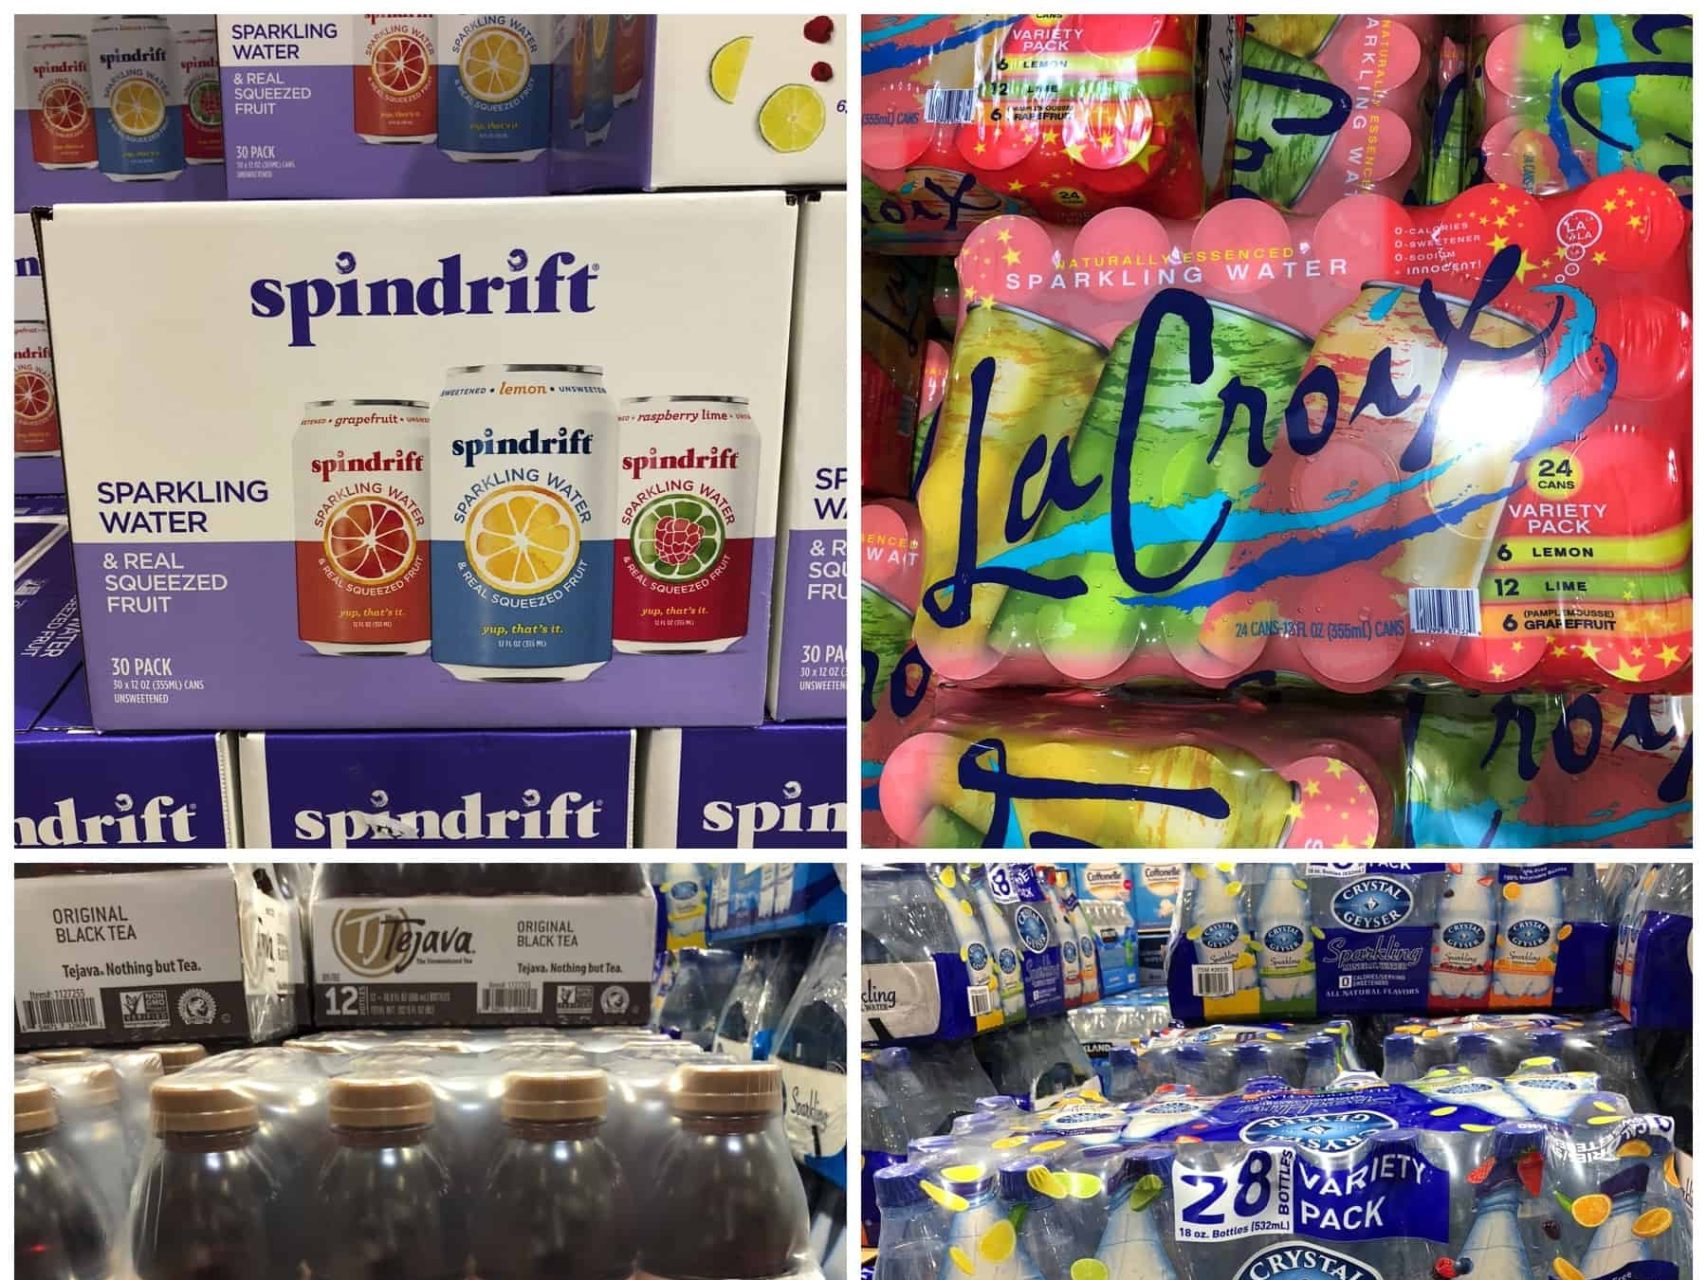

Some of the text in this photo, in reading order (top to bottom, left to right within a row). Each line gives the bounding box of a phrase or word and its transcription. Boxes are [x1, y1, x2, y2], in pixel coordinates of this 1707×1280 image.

[231, 23, 338, 41] SPARKLING
[1013, 29, 1084, 40] VARIETY
[232, 44, 300, 60] WATER
[1023, 41, 1069, 51] PACK
[234, 72, 284, 85] & REAL
[234, 87, 311, 100] SQUEEZED
[235, 103, 276, 115] FRUIT
[236, 145, 275, 159] 30 PACK
[1182, 247, 1294, 263] ESSENCED
[1006, 258, 1349, 289] SPARKLING WATER
[250, 250, 599, 347] spindrift
[499, 381, 547, 397] lemon
[334, 413, 398, 427] grapefruit
[637, 408, 728, 423] raspberry lime
[452, 427, 594, 467] spindrift
[312, 450, 424, 481] spindrift
[622, 448, 738, 479] spindrift
[1538, 459, 1573, 477] 24
[97, 481, 268, 504] SPARKLING
[1538, 481, 1575, 490] CANS
[1509, 503, 1607, 518] VARIETY
[98, 511, 208, 533] WATER
[1528, 519, 1591, 534] PACK
[103, 553, 184, 569] & REAL
[1497, 544, 1594, 562] 6 LEMON
[105, 574, 228, 591] SQUEEZED
[1494, 578, 1587, 597] 12 LIME
[108, 596, 171, 613] FRUIT
[1235, 621, 1405, 637] 24 CANS
[1503, 614, 1518, 632] 6
[1524, 619, 1616, 631] GRAPEFRUIT
[111, 658, 172, 676] 30 PACK
[114, 694, 169, 704] UNSWEETENED
[1342, 879, 1403, 900] CRYSTAL
[52, 905, 128, 924] ORIGINAL
[1342, 910, 1402, 930] GEYSER
[56, 925, 137, 943] BLACK TEA
[517, 920, 574, 933] ORIGINAL
[517, 935, 578, 947] BLACK TEA
[106, 958, 202, 977] Nothing but Tea.
[550, 963, 586, 975] Nothing
[324, 985, 359, 1016] 12
[1278, 1150, 1293, 1215] BOTTLES
[1299, 1154, 1426, 1196] VARIETY
[1301, 1197, 1386, 1231] PACK
[1212, 1224, 1249, 1238] Bottles
